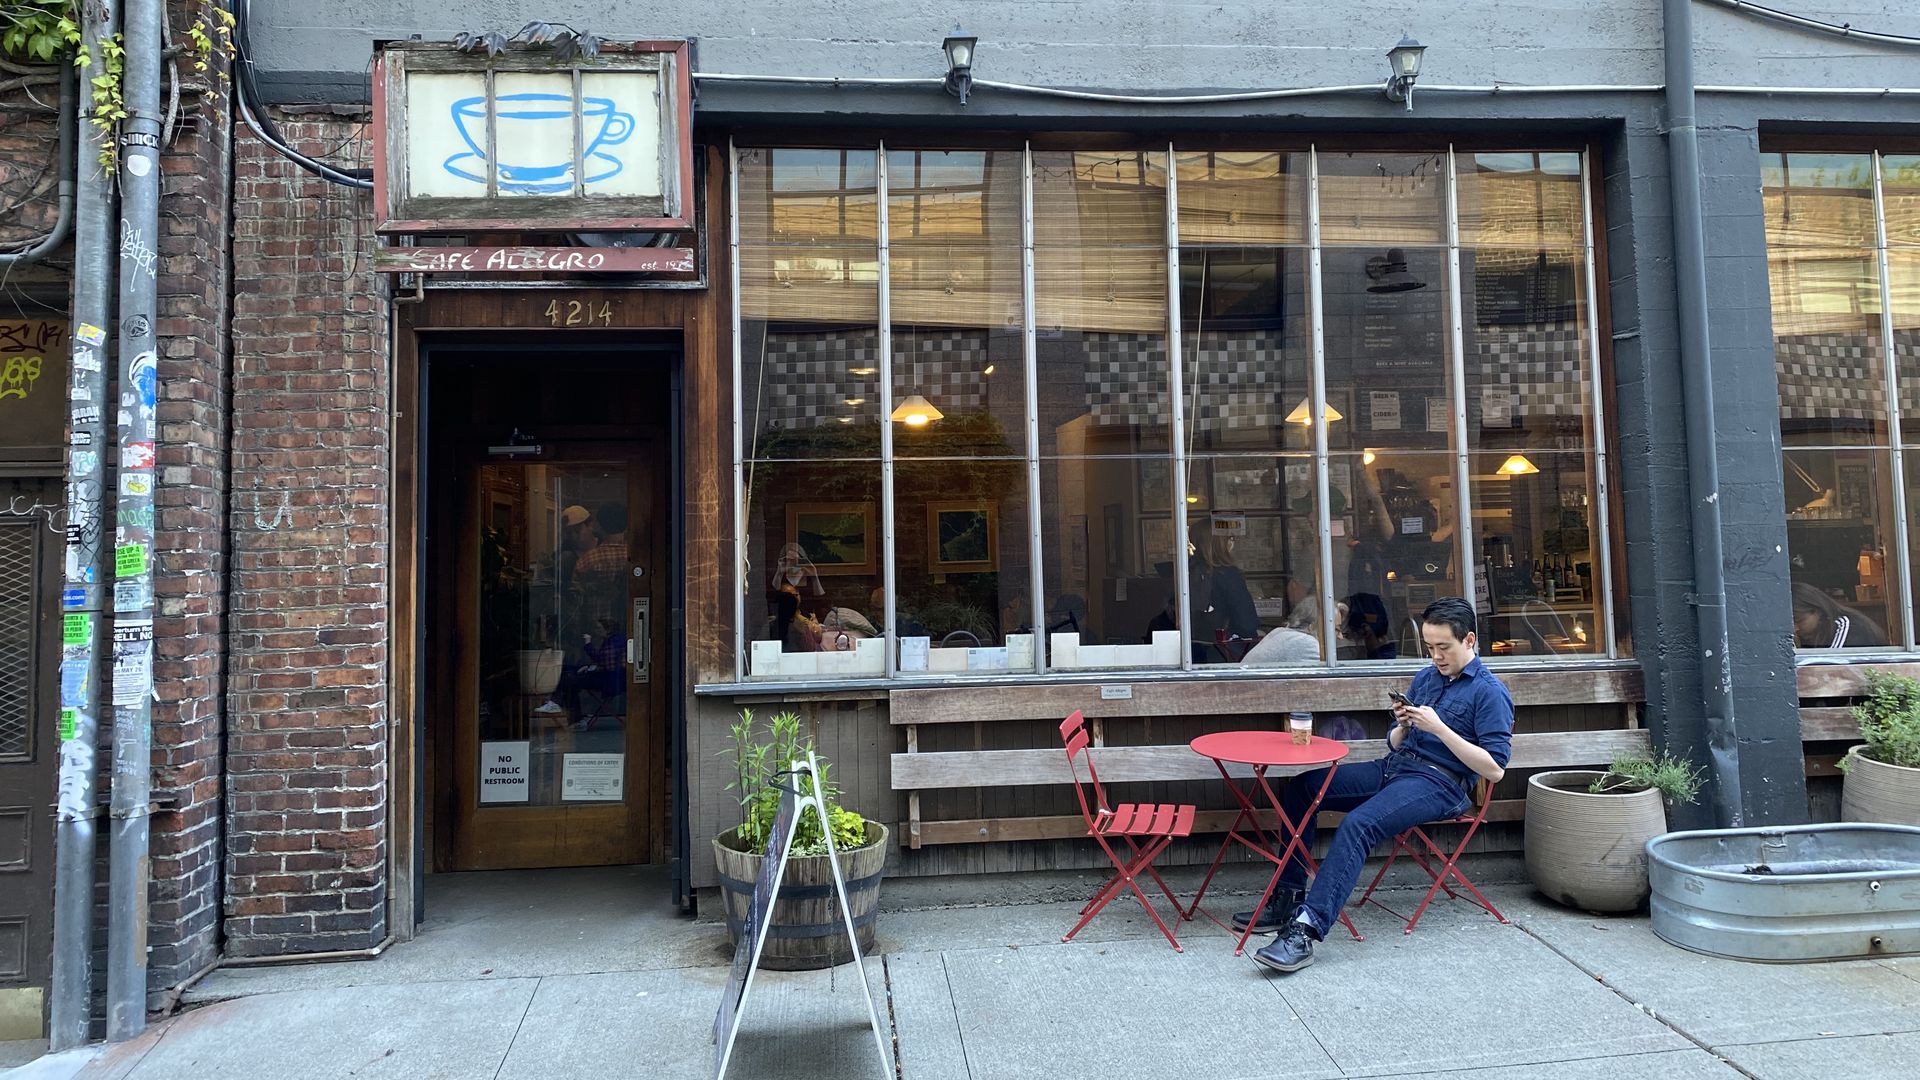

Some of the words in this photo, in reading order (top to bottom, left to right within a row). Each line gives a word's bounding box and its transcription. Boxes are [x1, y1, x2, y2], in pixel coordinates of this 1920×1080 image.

[545, 299, 612, 327] 4214
[140, 631, 153, 640] NO
[498, 755, 512, 763] NO
[484, 777, 525, 785] RESTROOM
